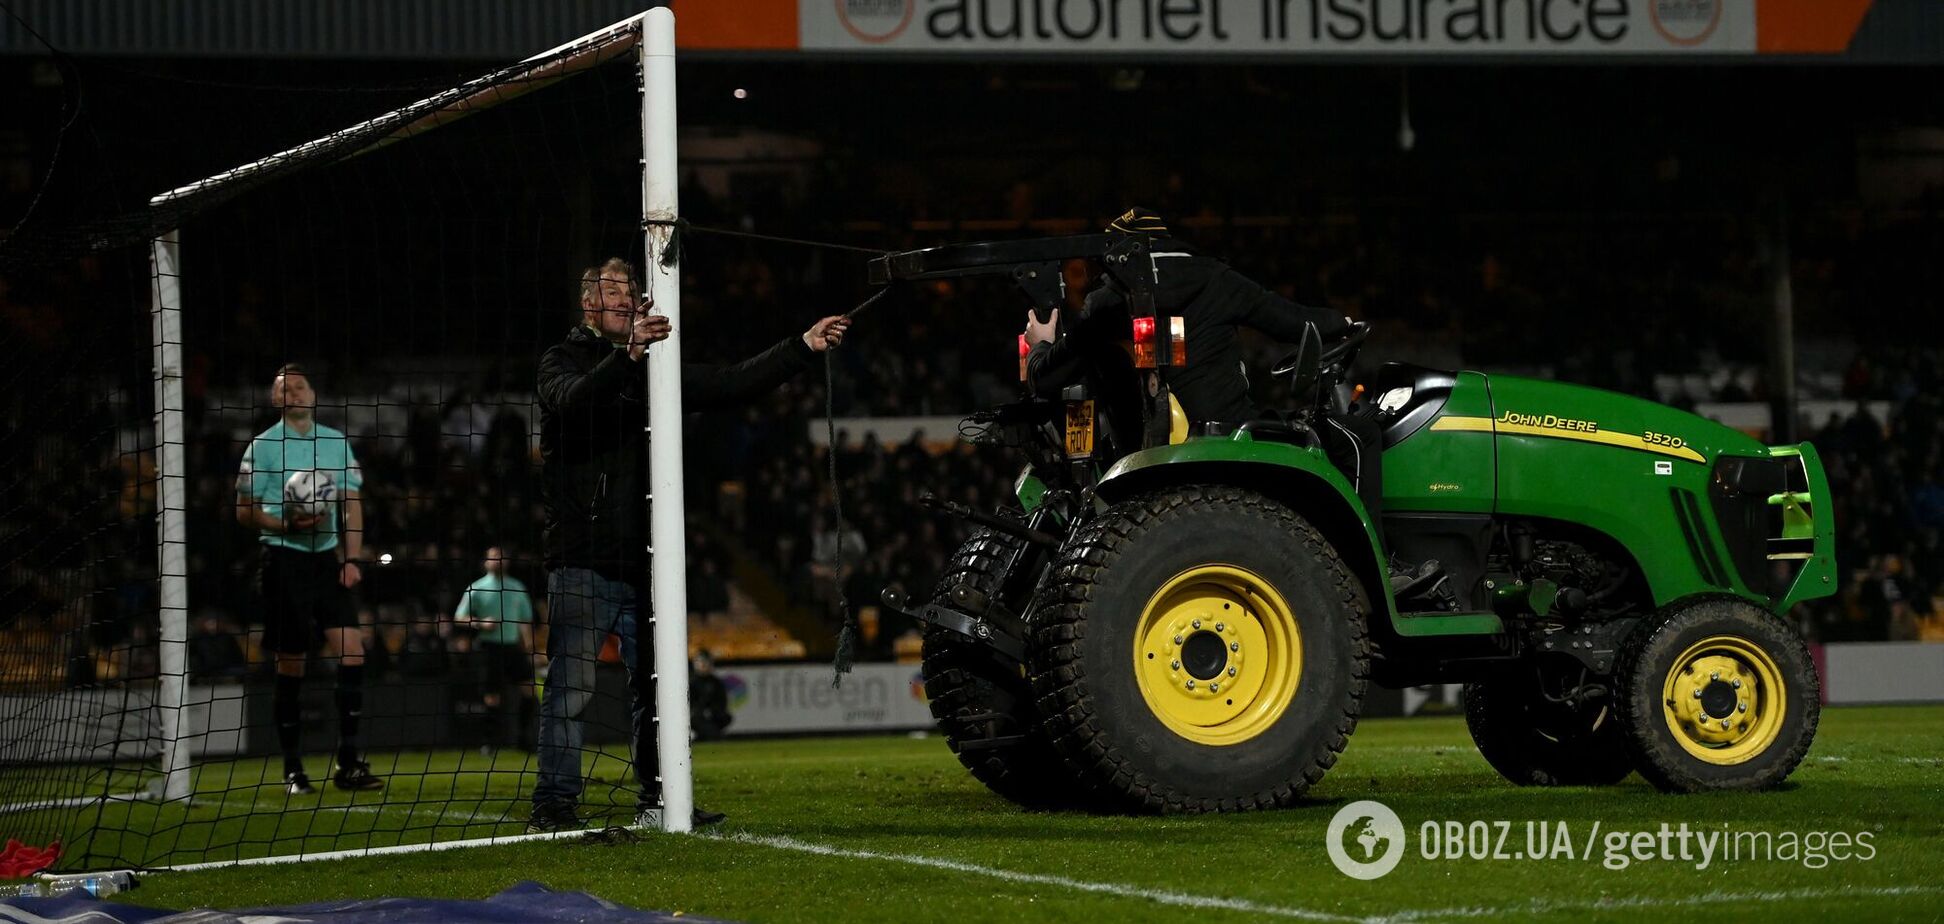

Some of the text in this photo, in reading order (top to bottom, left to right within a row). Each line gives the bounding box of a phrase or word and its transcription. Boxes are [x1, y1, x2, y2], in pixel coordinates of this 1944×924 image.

[925, 0, 1229, 41] autonet
[1260, 0, 1631, 42] insurance
[1498, 410, 1598, 433] JOHN DEERE
[1642, 431, 1682, 448] 3520
[757, 669, 889, 710] fifteen
